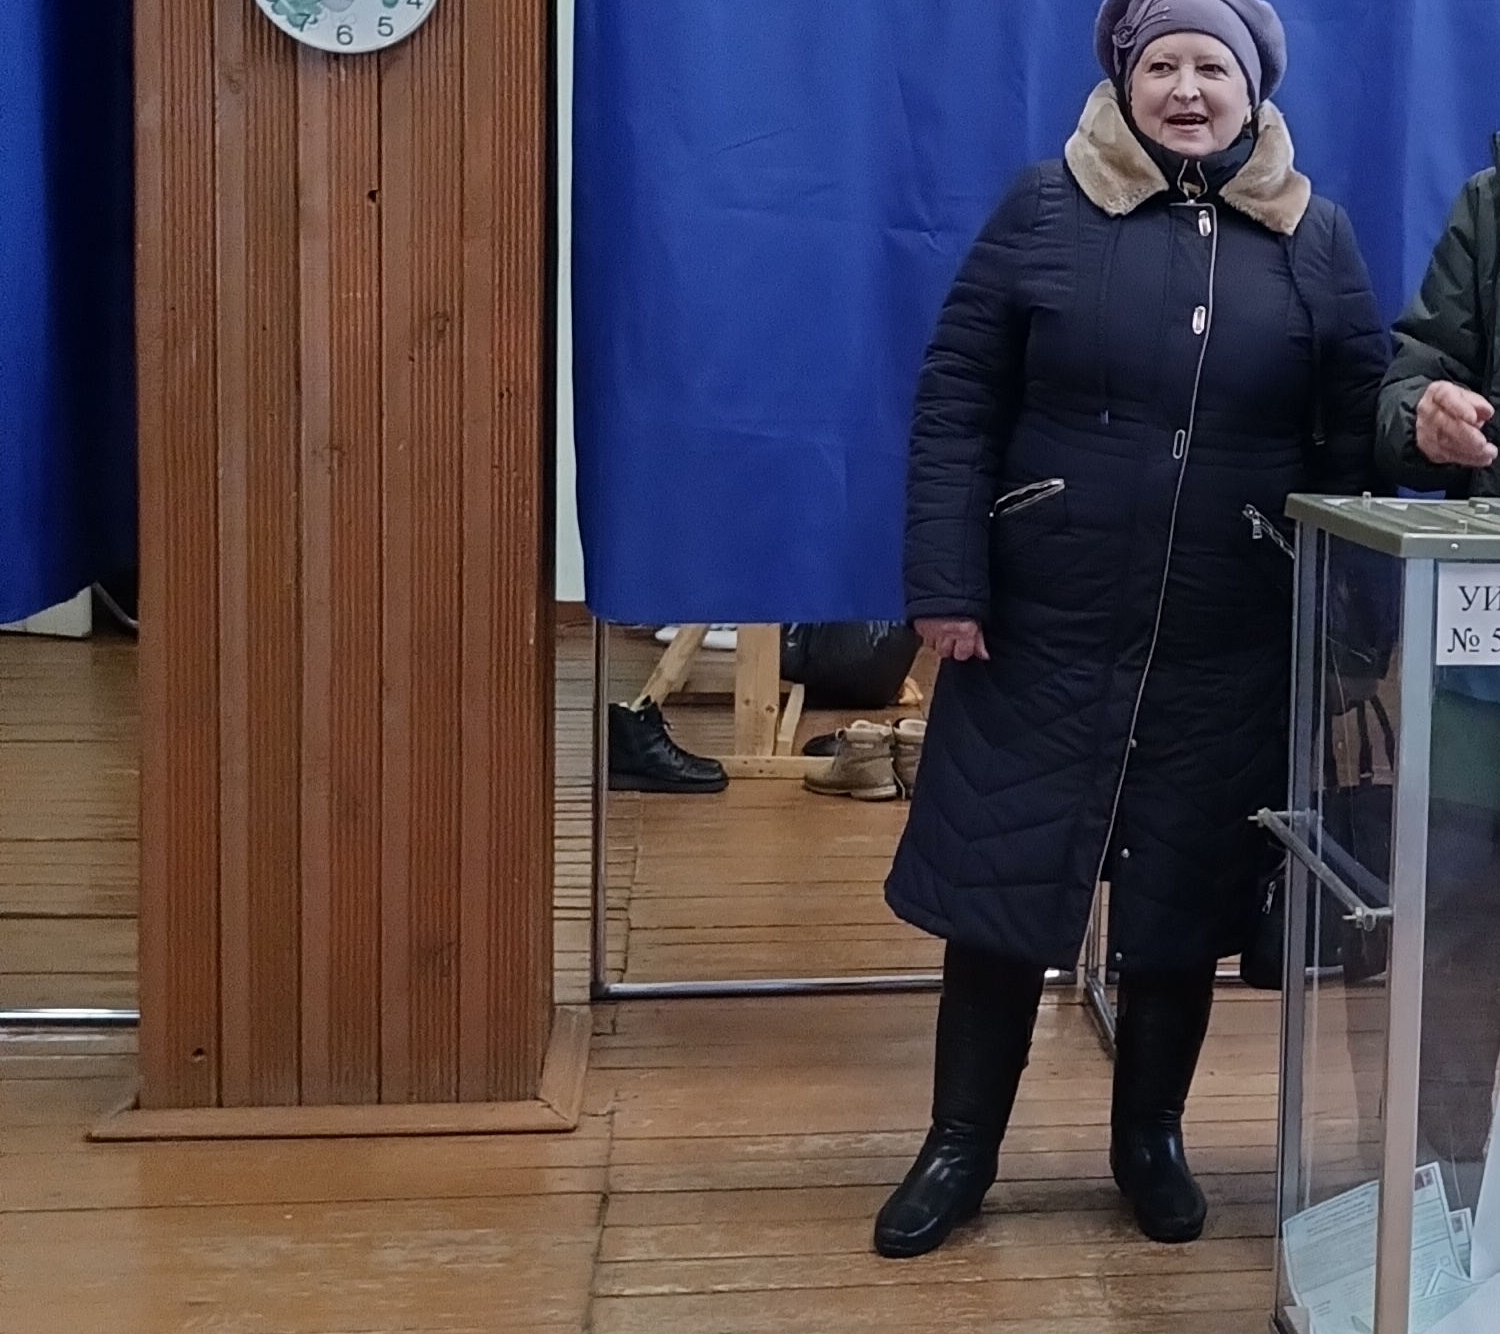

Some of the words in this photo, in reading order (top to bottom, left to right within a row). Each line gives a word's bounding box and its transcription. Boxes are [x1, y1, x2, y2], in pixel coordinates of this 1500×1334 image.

[296, 13, 311, 32] 7
[377, 16, 394, 37] 5
[336, 24, 353, 45] 6
[1447, 627, 1481, 653] №
